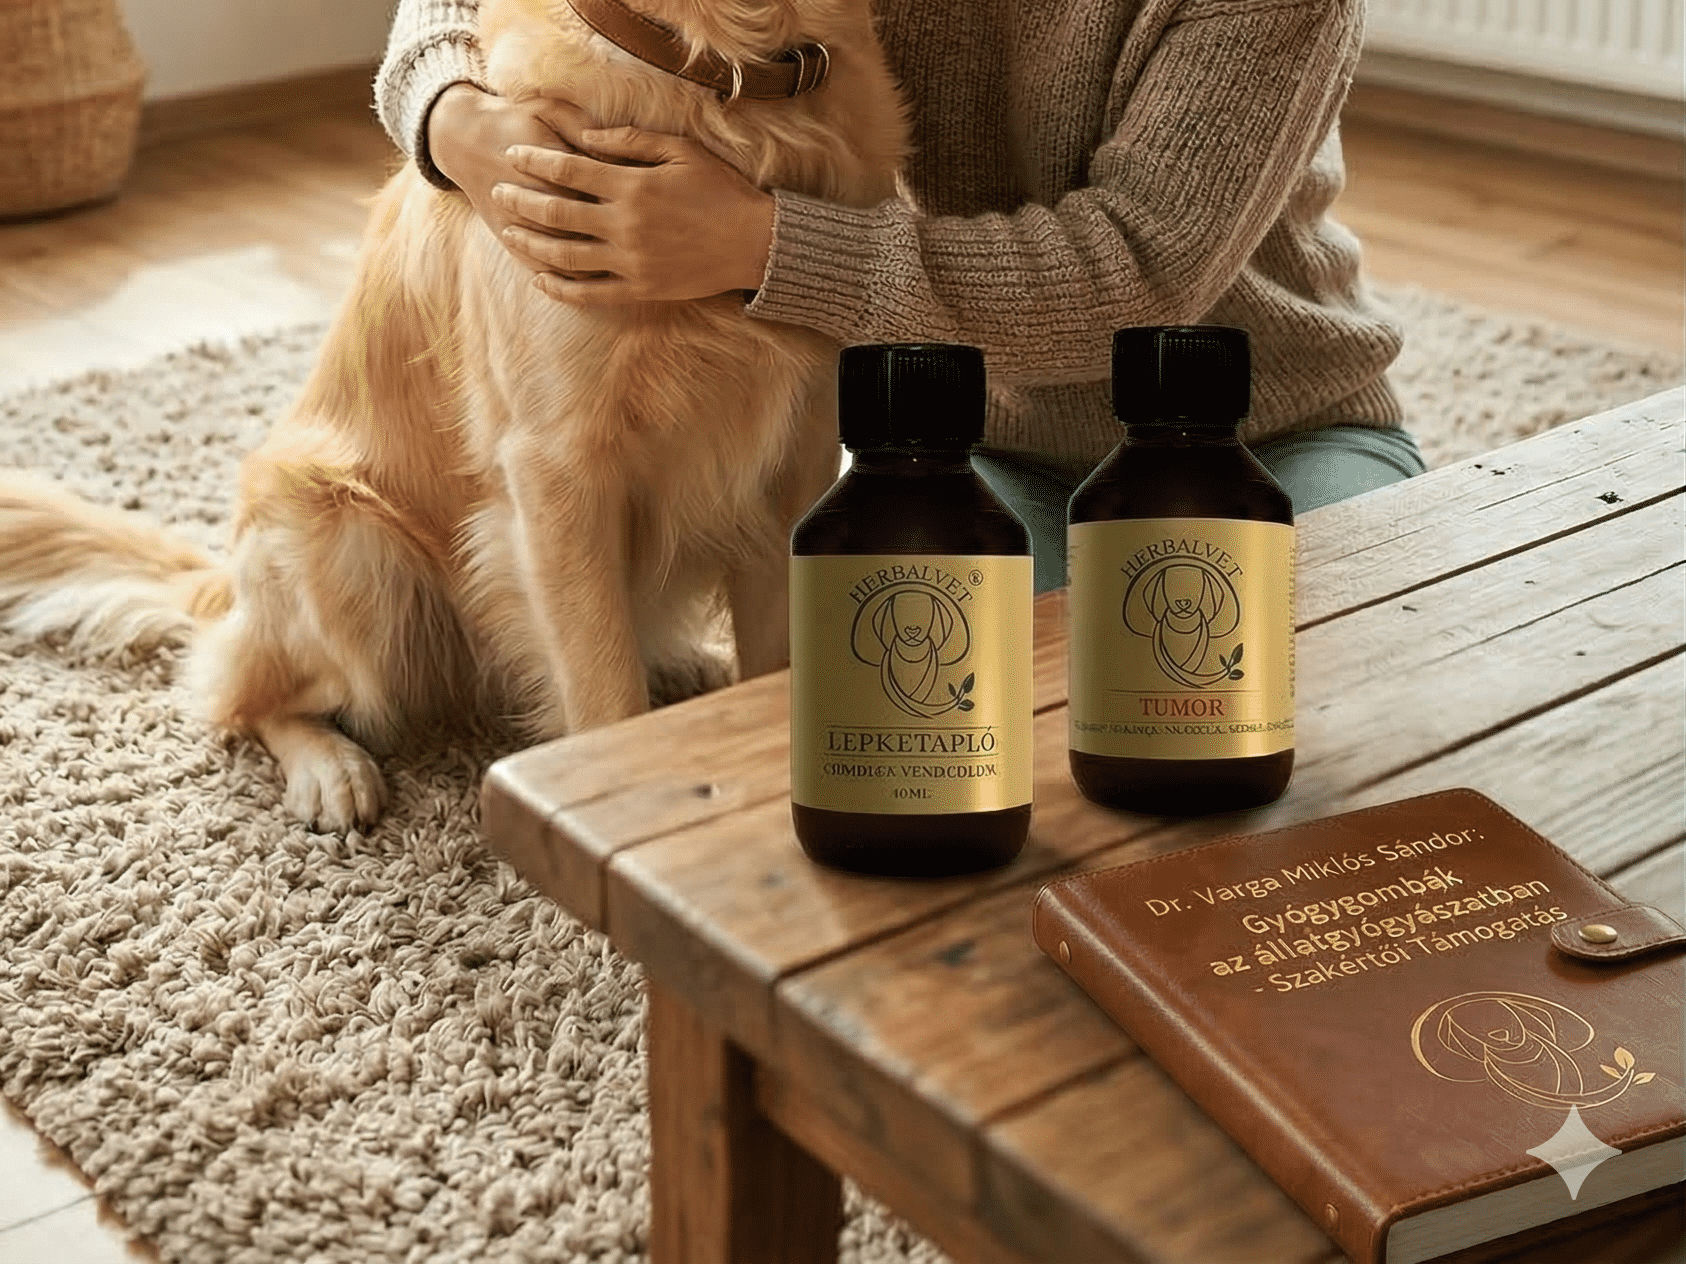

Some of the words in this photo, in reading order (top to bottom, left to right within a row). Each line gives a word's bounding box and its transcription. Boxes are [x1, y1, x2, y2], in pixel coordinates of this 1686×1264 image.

[1120, 539, 1243, 579] HERBALVET
[1139, 698, 1225, 717] TUMOR
[827, 726, 995, 753] LEPKETAPLÓ
[1145, 899, 1192, 917] Dr.
[1192, 877, 1282, 905] Varga
[1281, 852, 1376, 885] Miklós
[1377, 828, 1484, 861] Sándor:
[1242, 866, 1463, 934] Gyógygombák
[1210, 955, 1250, 976] az
[1254, 880, 1550, 966] állatgyógyászatban
[1405, 905, 1568, 954] Támogatás
